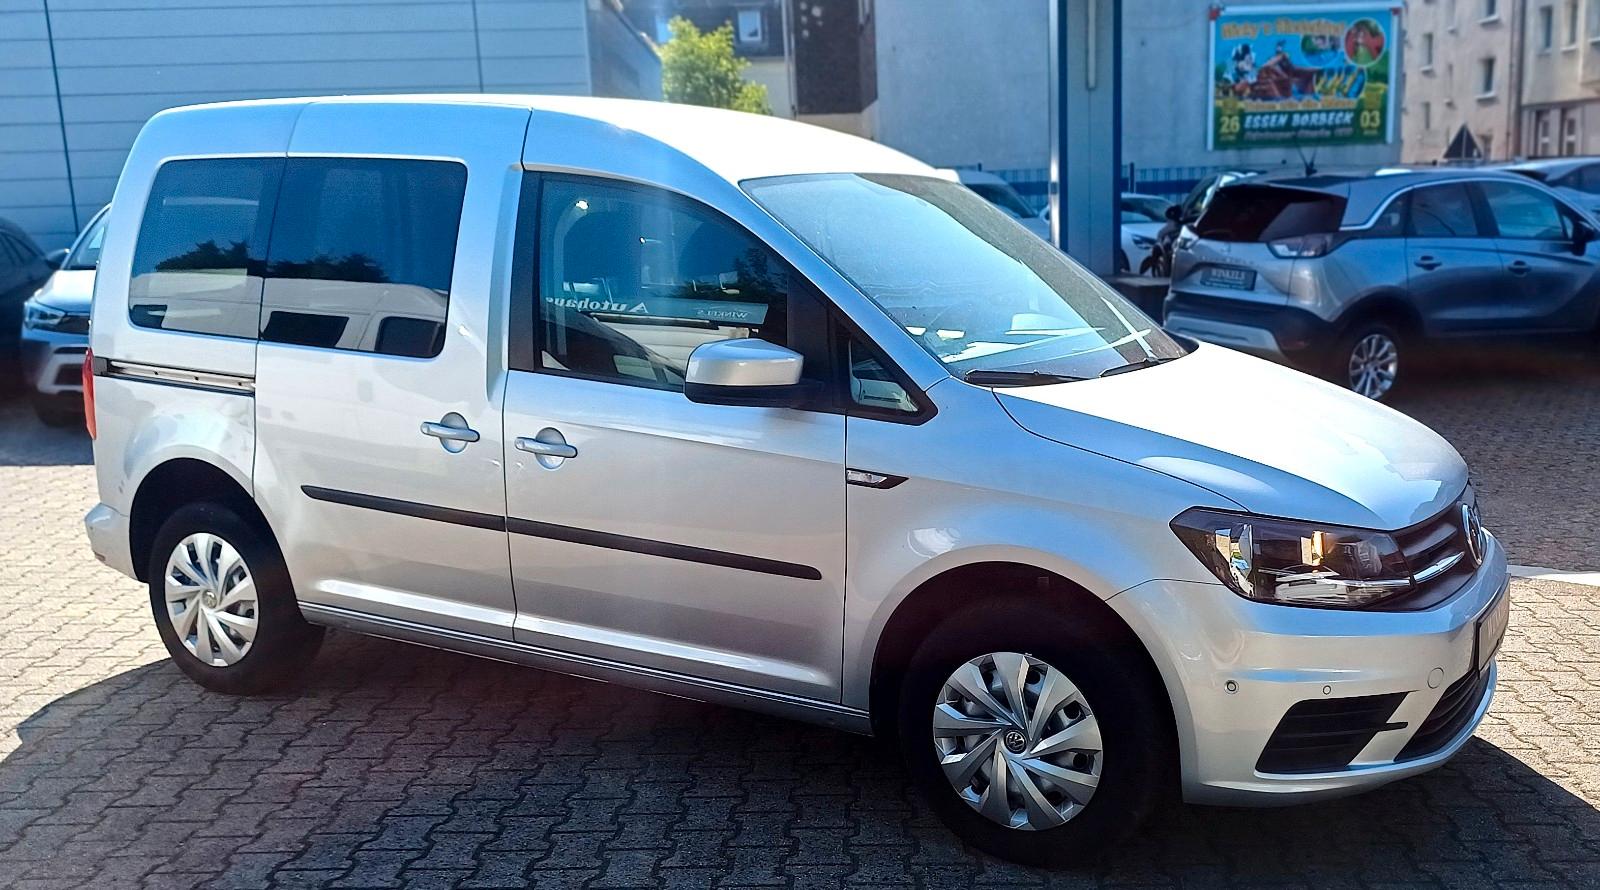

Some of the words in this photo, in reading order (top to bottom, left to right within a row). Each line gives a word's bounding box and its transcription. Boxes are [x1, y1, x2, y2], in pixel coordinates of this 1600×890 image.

[1219, 116, 1240, 133] 26
[1244, 114, 1288, 129] ESSEN
[1291, 111, 1355, 128] BORBECK
[1360, 110, 1380, 128] 03
